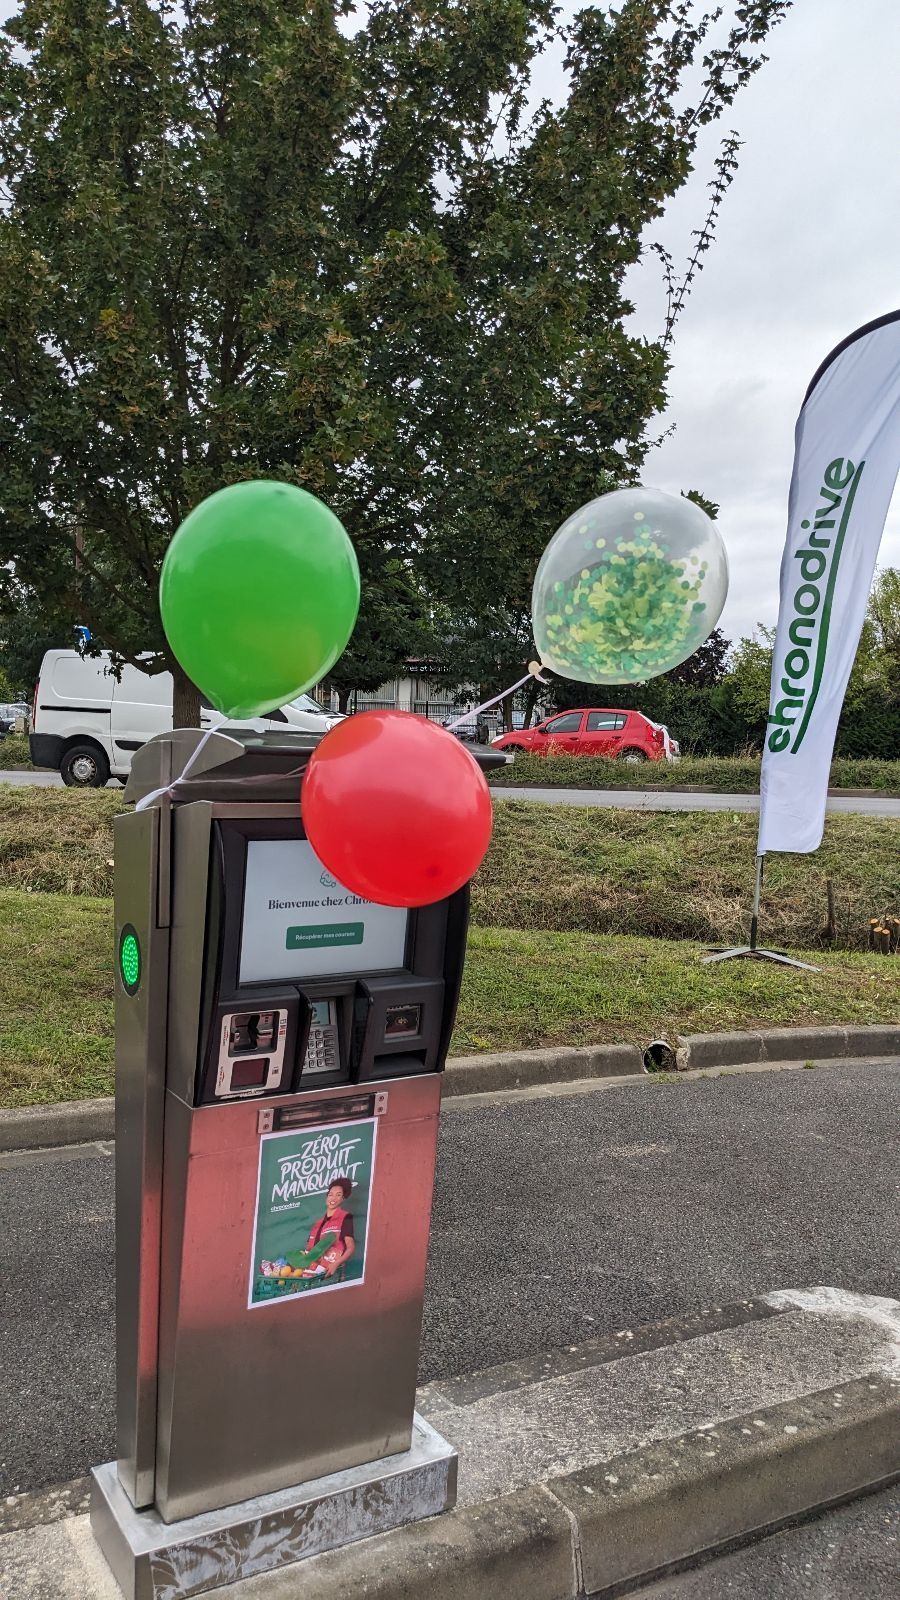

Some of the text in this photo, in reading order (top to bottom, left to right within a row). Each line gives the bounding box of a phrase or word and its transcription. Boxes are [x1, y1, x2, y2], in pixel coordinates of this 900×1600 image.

[768, 457, 855, 752] chronodrive
[268, 895, 375, 910] Bienvenue chez Chro
[280, 1146, 356, 1184] PRODUIT
[301, 1134, 340, 1159] ZÉRO
[271, 1162, 363, 1203] MANQUANT
